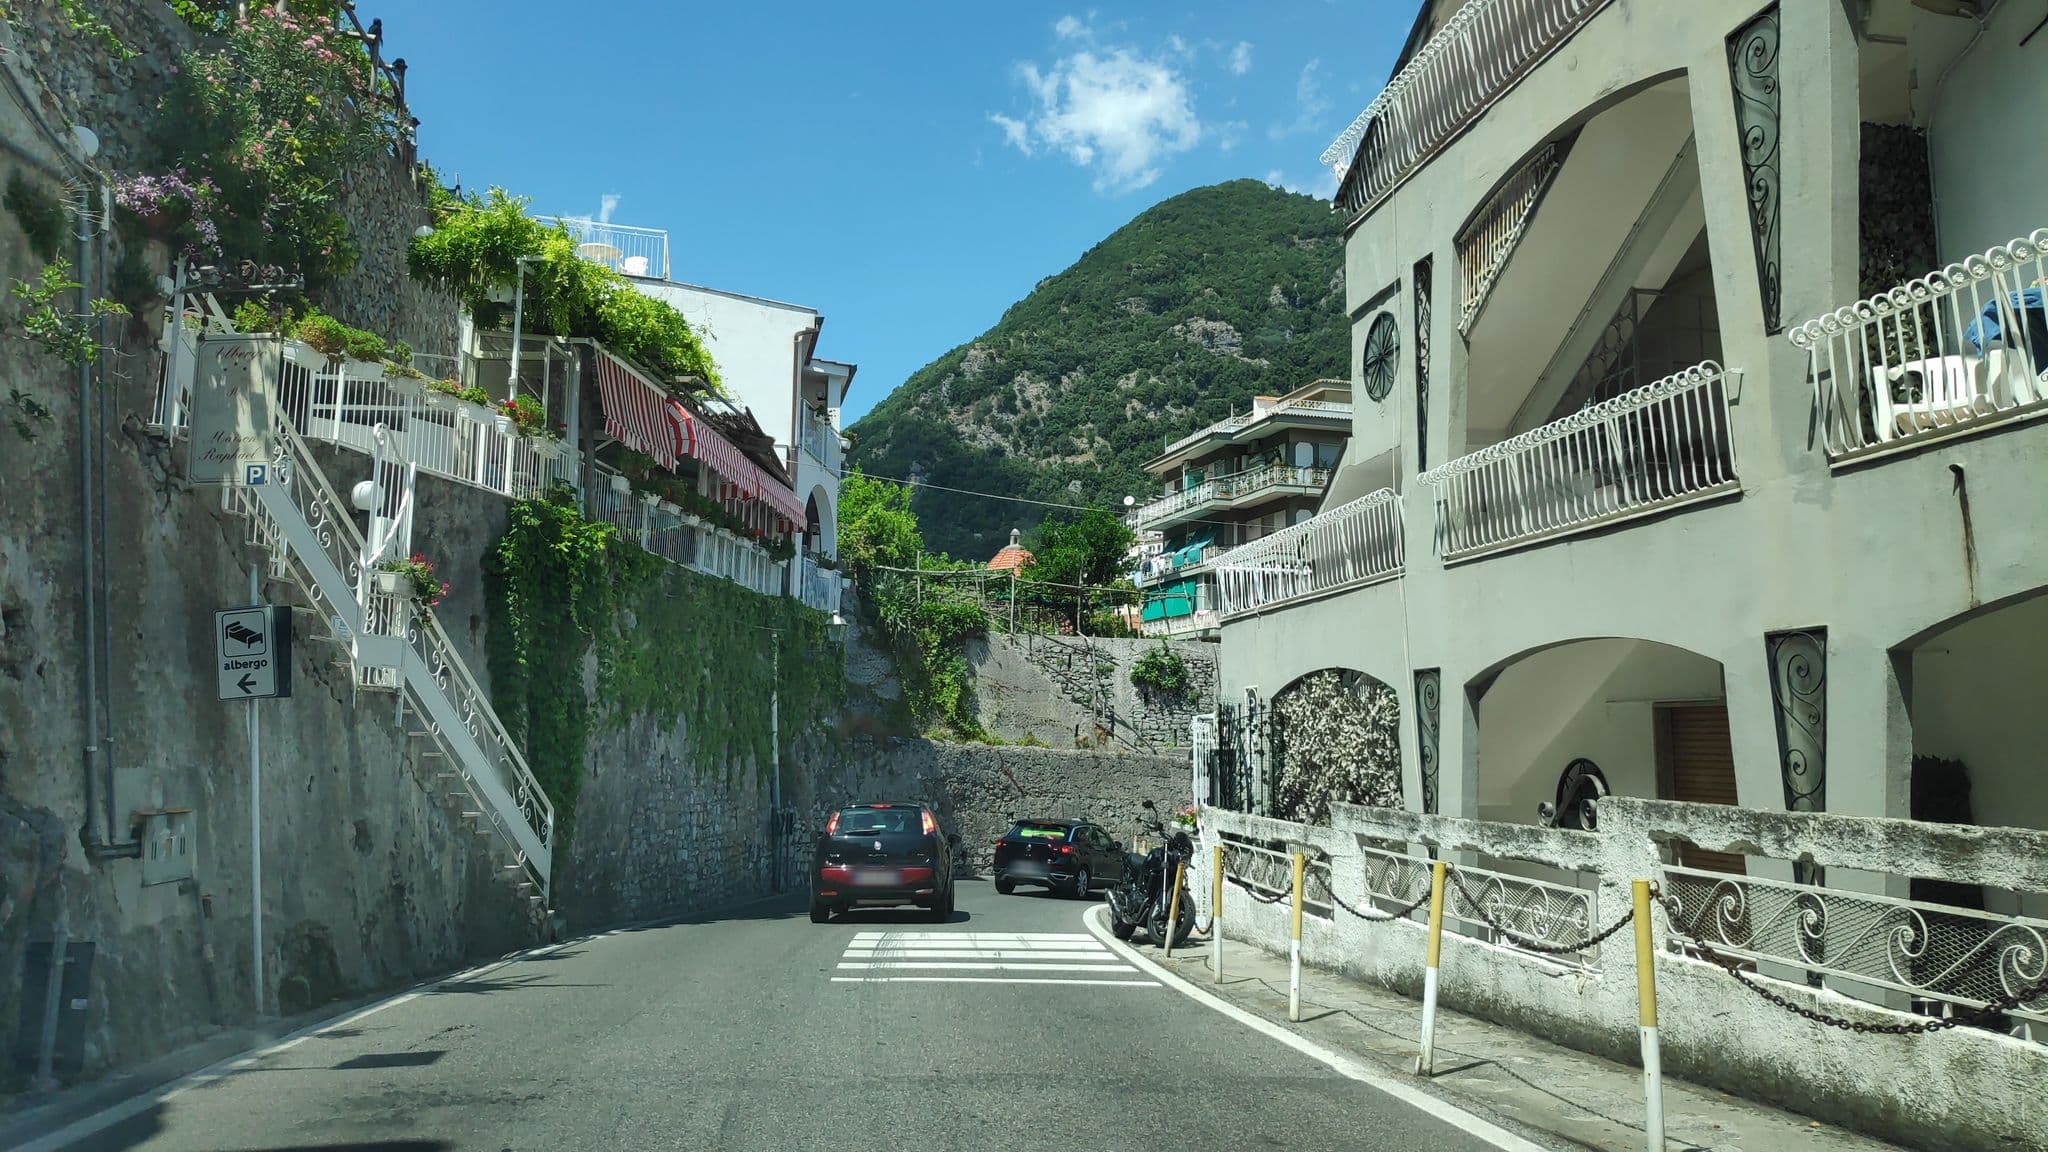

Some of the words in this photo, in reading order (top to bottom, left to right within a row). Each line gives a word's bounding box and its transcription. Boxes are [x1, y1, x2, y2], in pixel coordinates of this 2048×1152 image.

[210, 430, 257, 443] Maison
[250, 467, 263, 484] P
[223, 659, 268, 671] albergo
